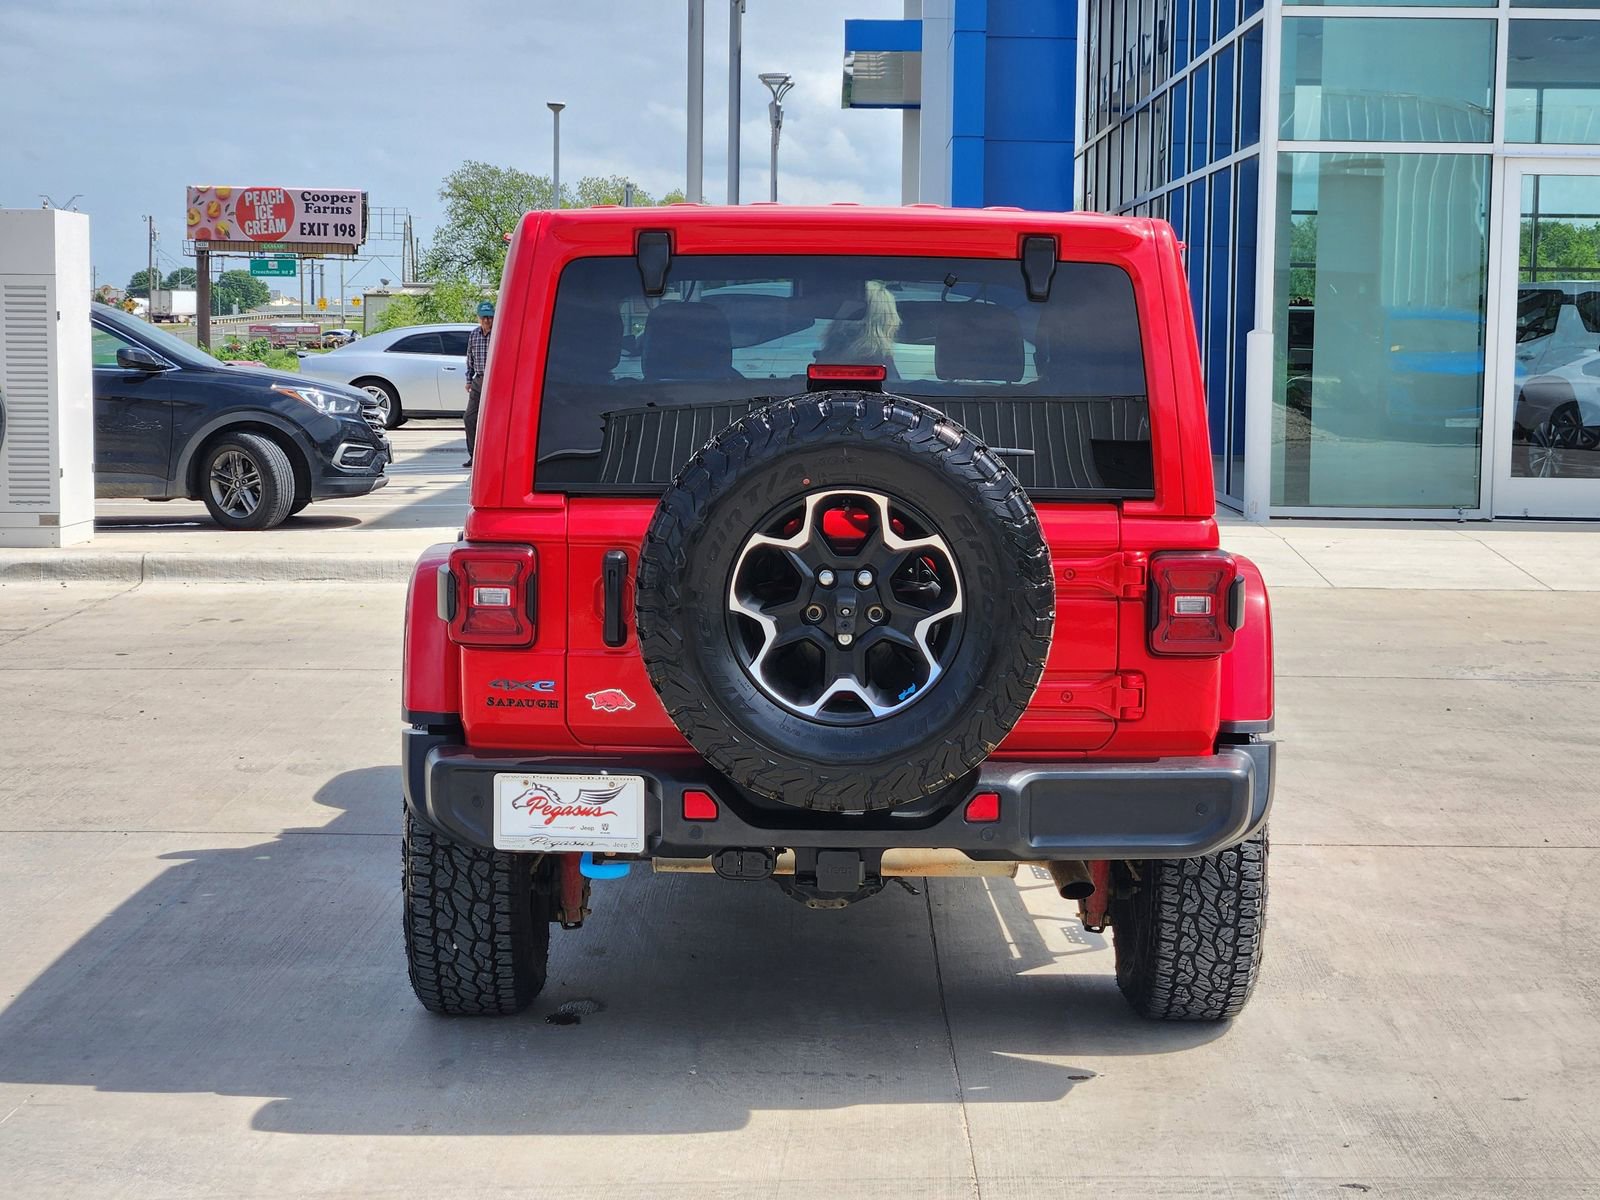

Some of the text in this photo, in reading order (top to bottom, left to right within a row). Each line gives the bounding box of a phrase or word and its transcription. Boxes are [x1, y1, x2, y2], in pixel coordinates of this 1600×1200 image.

[244, 189, 285, 206] PEACH
[300, 191, 357, 204] Cooper
[254, 204, 274, 220] ICE
[304, 203, 352, 215] Farms
[244, 218, 287, 236] CREAM
[300, 222, 357, 238] EXIT 198
[486, 696, 559, 709] SAPAUGH
[527, 795, 618, 826] Pegasus
[529, 836, 609, 848] Pegasus
